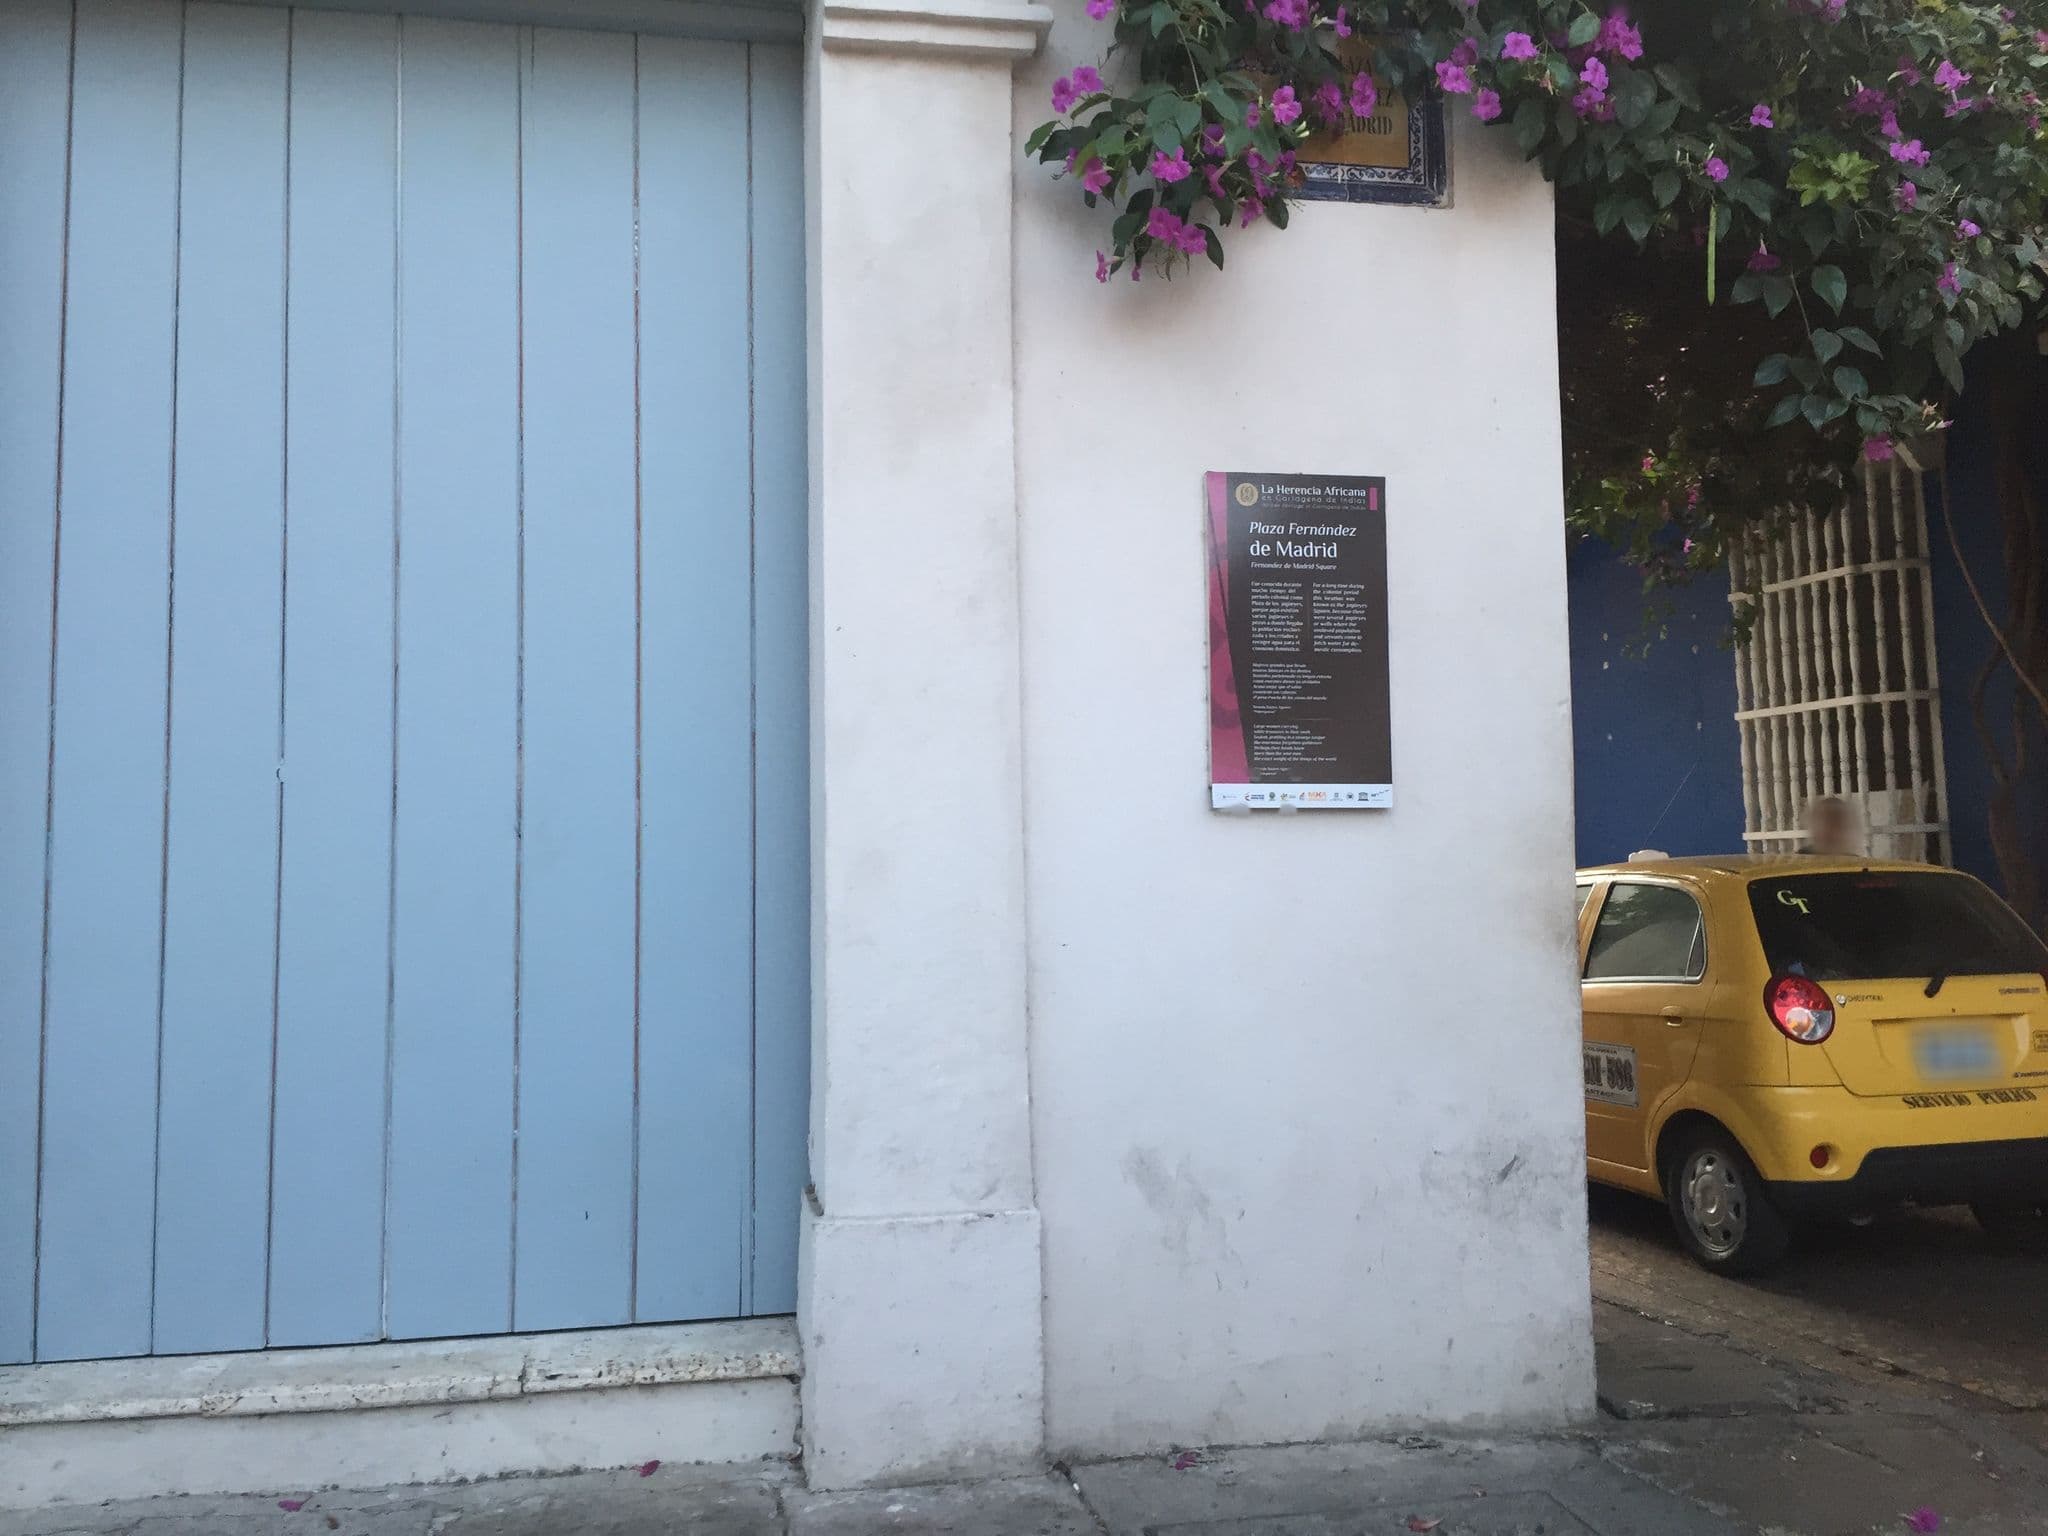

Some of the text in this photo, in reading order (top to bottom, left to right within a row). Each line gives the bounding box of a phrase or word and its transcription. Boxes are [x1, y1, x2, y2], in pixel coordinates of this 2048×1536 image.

[1261, 484, 1367, 497] La Herencia Africana
[1275, 495, 1322, 504] Cartagena
[1341, 496, 1366, 505] Indias
[1249, 521, 1357, 537] Plaza Fernández
[1250, 540, 1338, 558] de Madrid
[1293, 562, 1315, 570] Madrid
[1316, 563, 1337, 571] Square
[1902, 1094, 1972, 1109] SERVICIO
